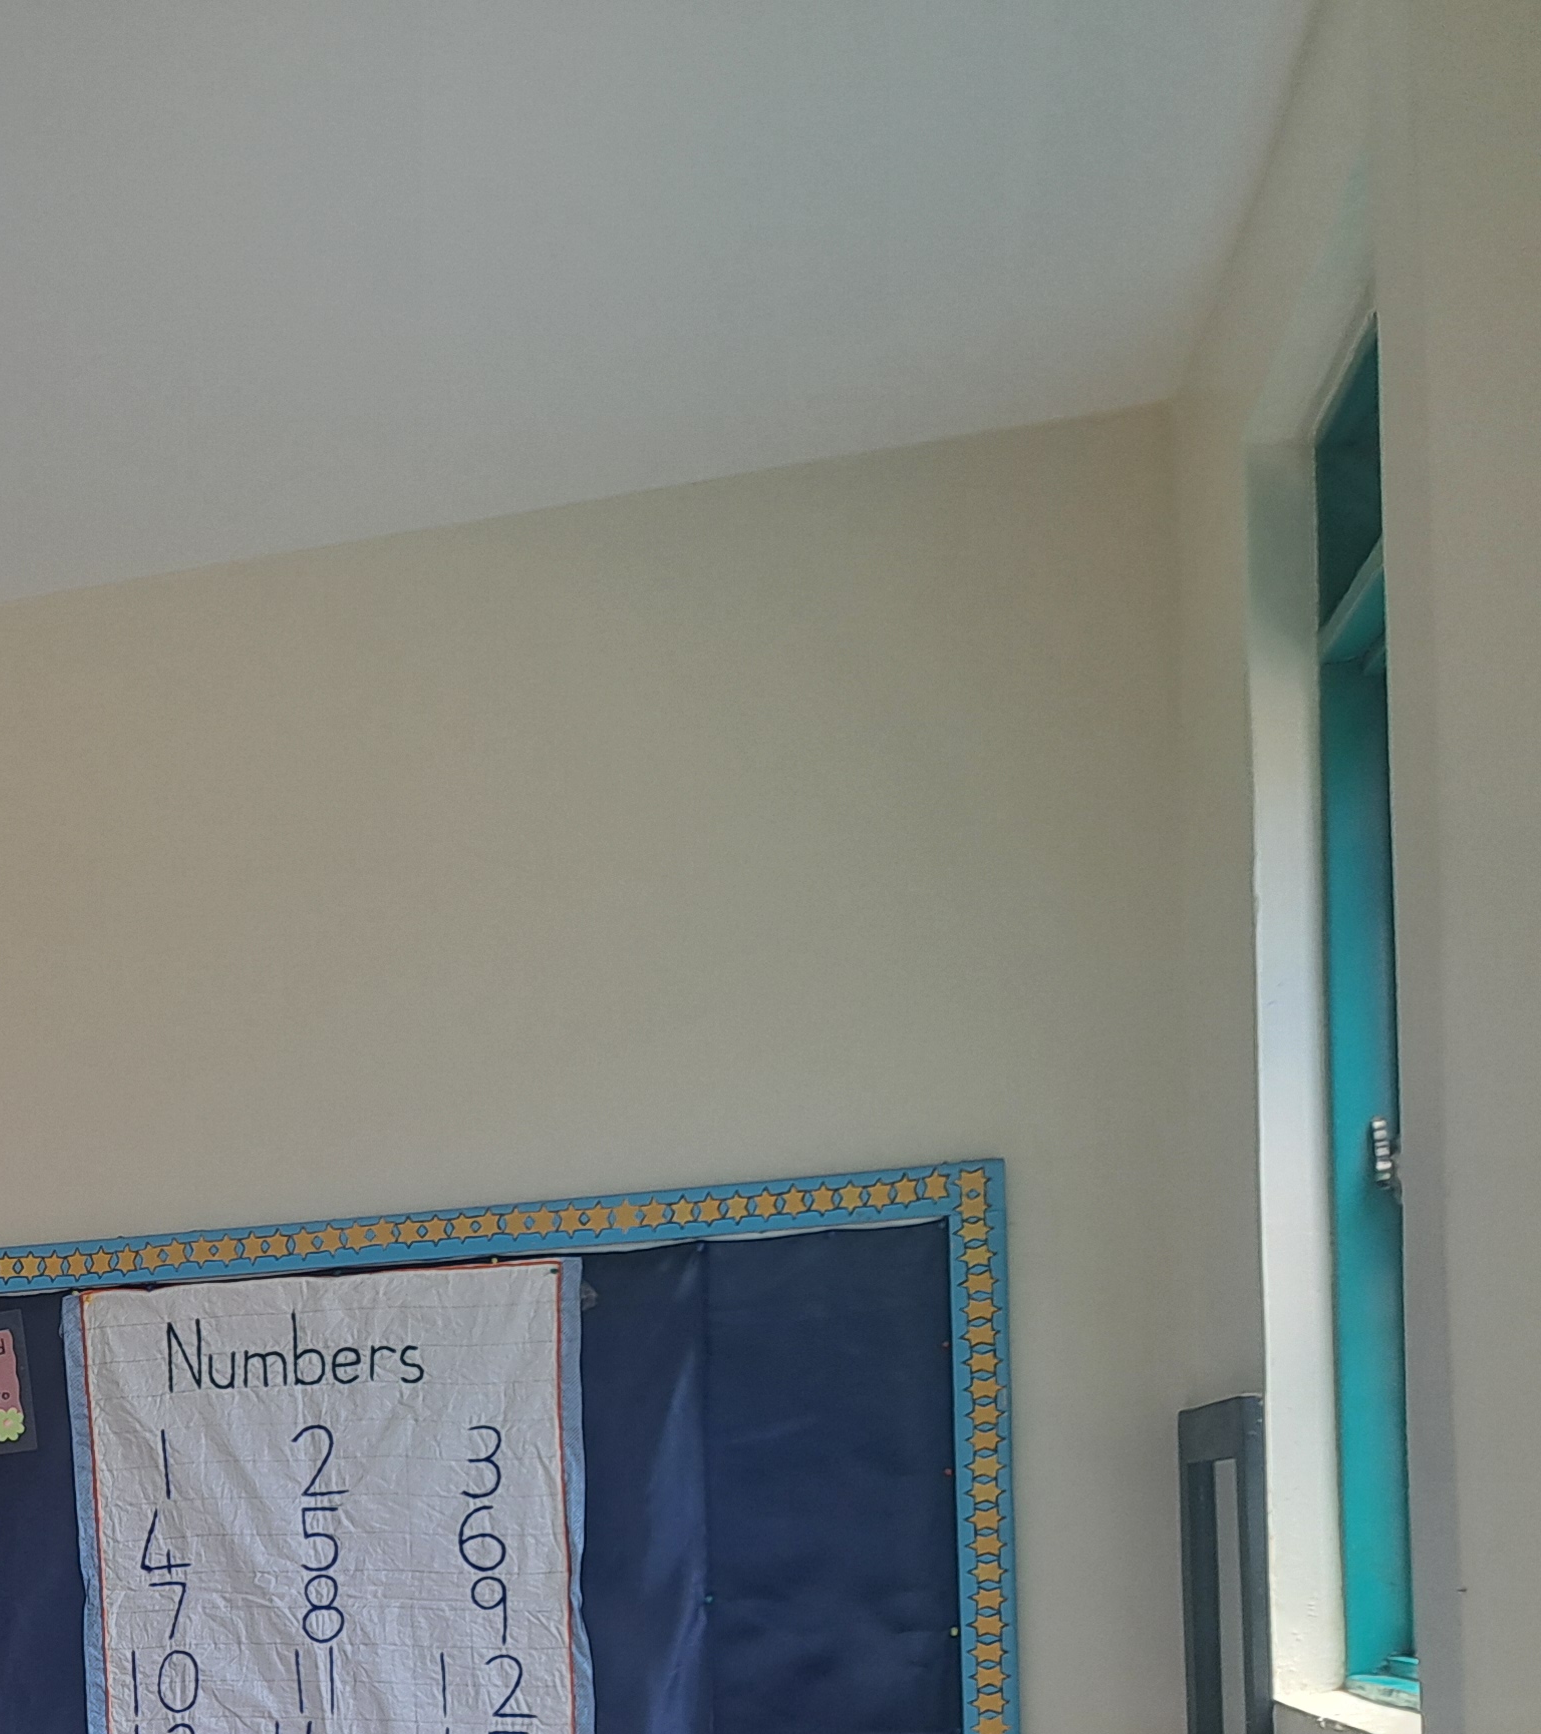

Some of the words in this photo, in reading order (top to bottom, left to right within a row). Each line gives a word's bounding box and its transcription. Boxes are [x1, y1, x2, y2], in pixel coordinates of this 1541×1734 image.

[166, 1307, 425, 1393] Numbers
[160, 1428, 171, 1500] 1
[291, 1424, 349, 1498] 2
[461, 1424, 502, 1499] 3
[140, 1508, 192, 1574] 4
[301, 1506, 339, 1572] 5
[458, 1505, 506, 1572] 6
[148, 1580, 187, 1640] 7
[302, 1574, 345, 1643] 8
[470, 1575, 507, 1646] 9
[131, 1649, 199, 1717] 10
[295, 1645, 334, 1715] 11
[439, 1651, 538, 1718] 12
